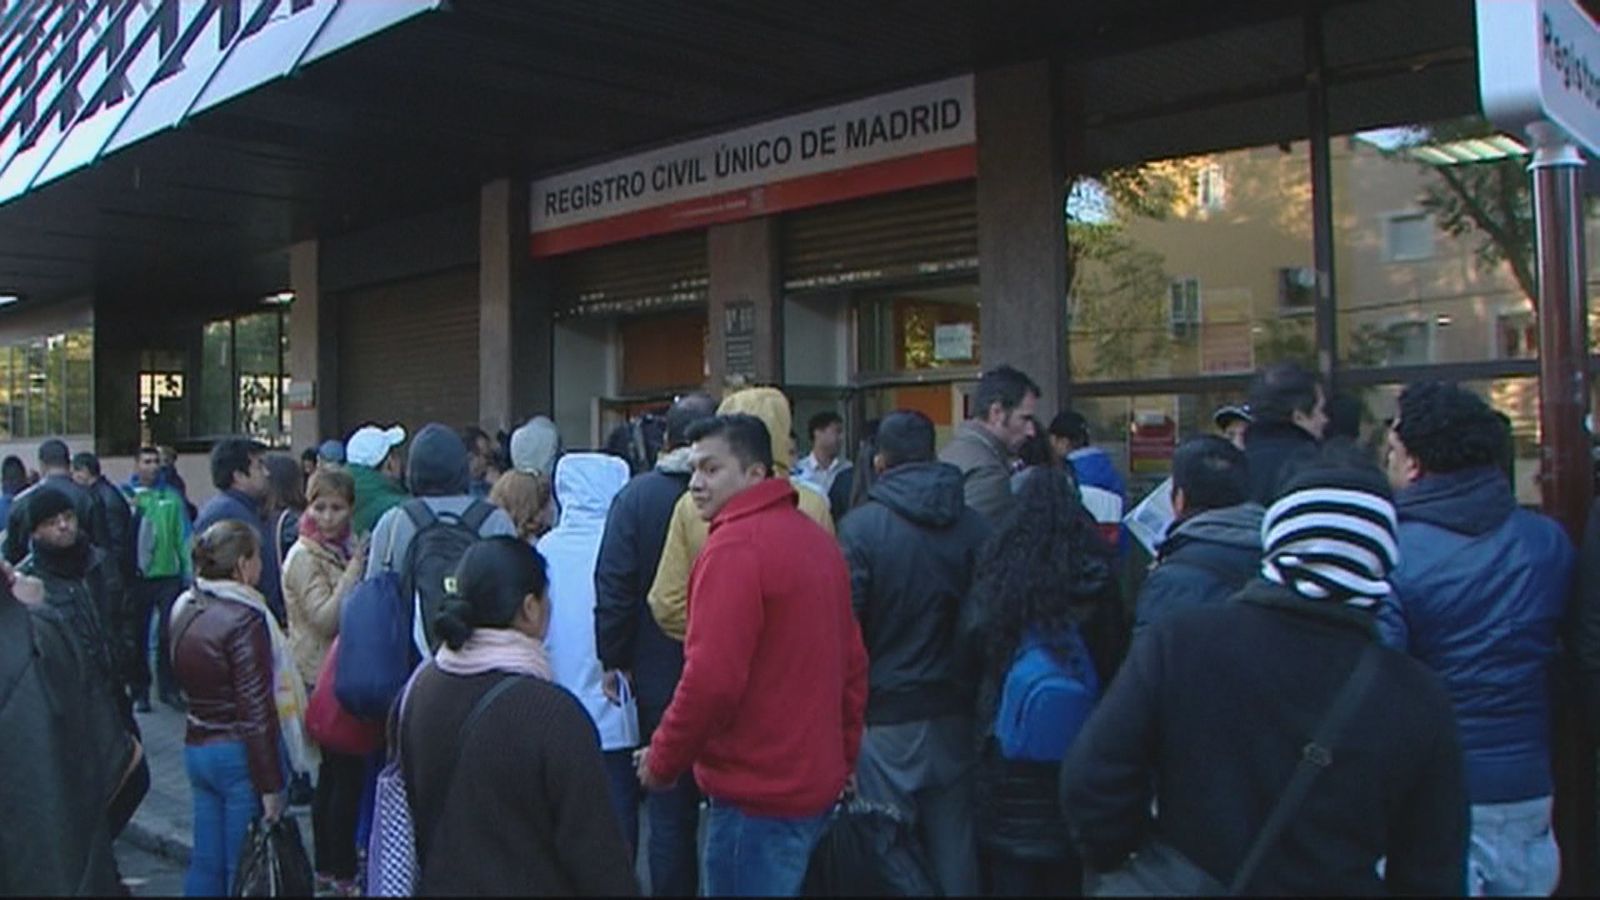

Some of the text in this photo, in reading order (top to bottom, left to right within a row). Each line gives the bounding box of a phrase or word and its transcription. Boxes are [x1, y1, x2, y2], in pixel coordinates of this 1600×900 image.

[544, 170, 646, 217] REGISTRO
[652, 159, 707, 192] CIVIL
[715, 136, 792, 177] ÚNICO
[801, 125, 836, 160] DE
[845, 98, 962, 149] MADRID
